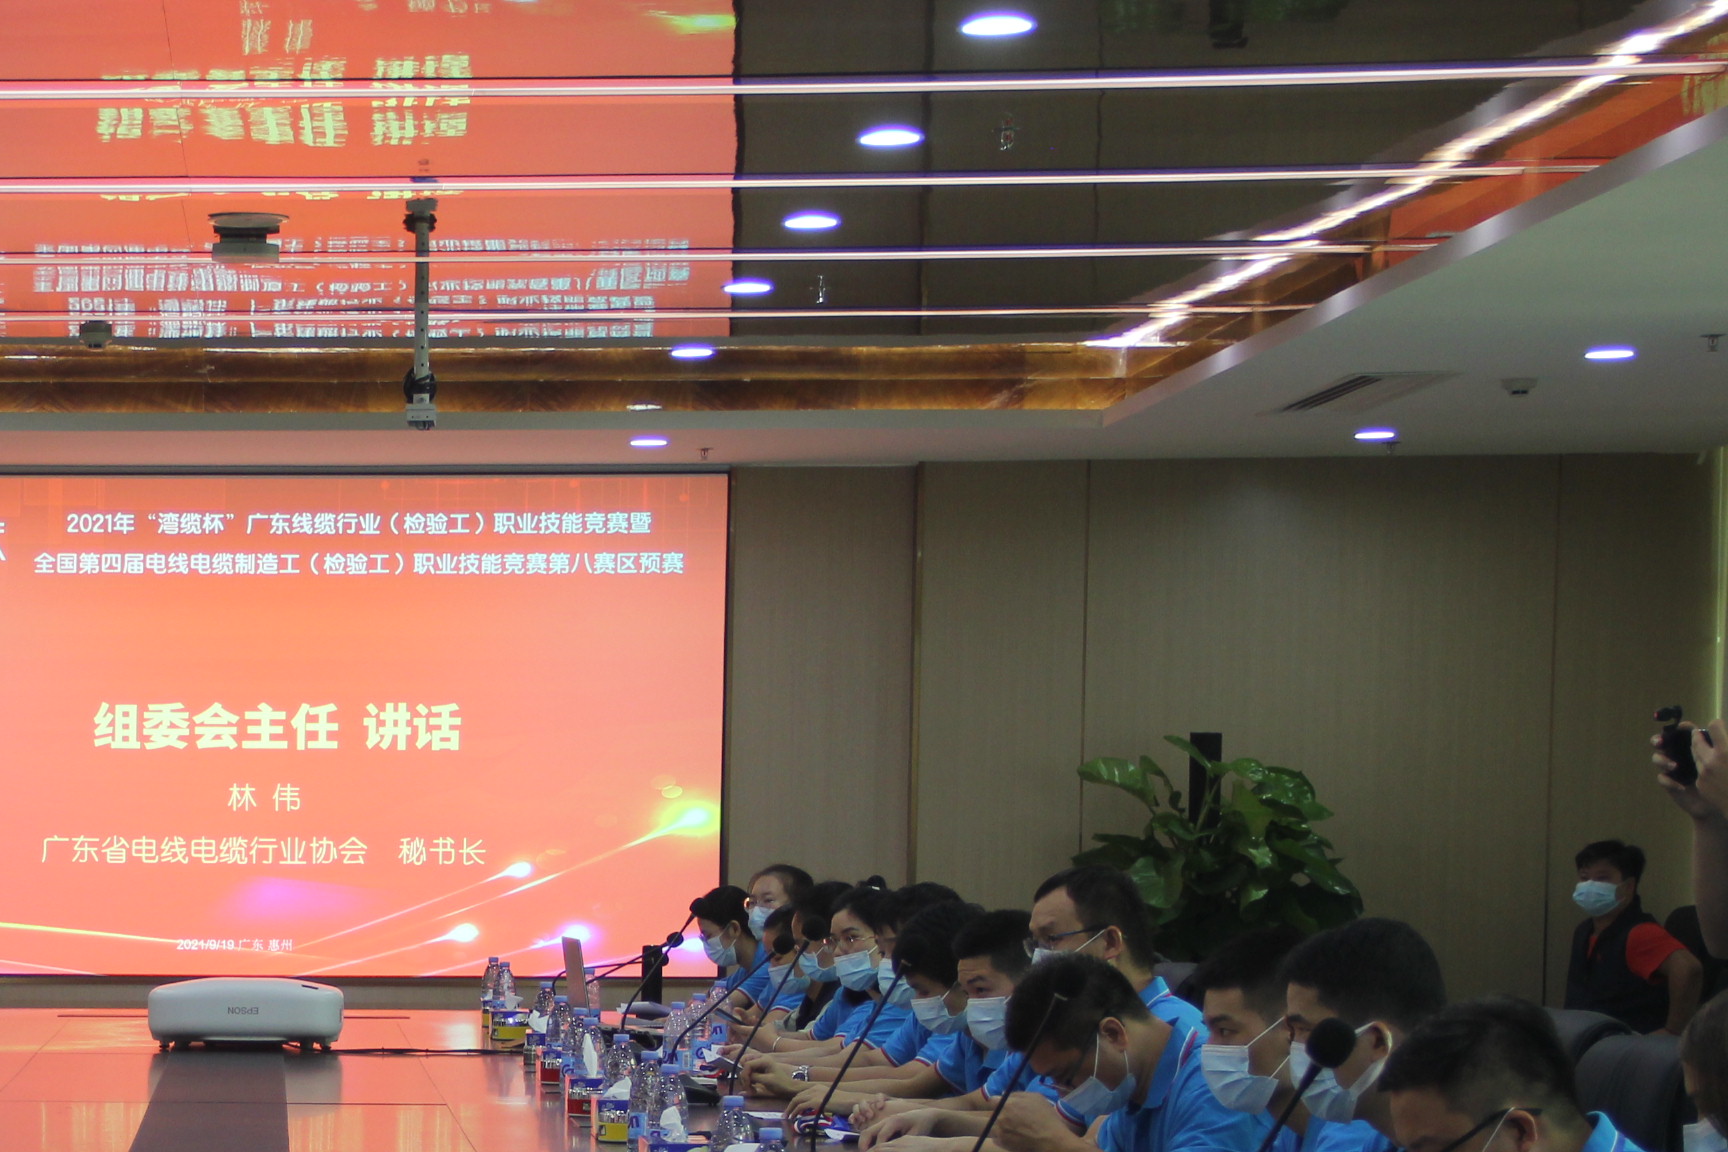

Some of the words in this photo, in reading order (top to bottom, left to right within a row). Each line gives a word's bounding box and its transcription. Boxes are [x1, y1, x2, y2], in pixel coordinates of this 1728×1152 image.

[93, 702, 339, 751] 组委会主任
[363, 702, 462, 751] 讲话
[41, 835, 368, 865] 广东省电线电缆行业协会
[398, 837, 487, 866] 秘书长
[176, 939, 235, 951] 2021/9/19
[238, 938, 264, 951] 广东
[227, 1006, 259, 1016] EPSON
